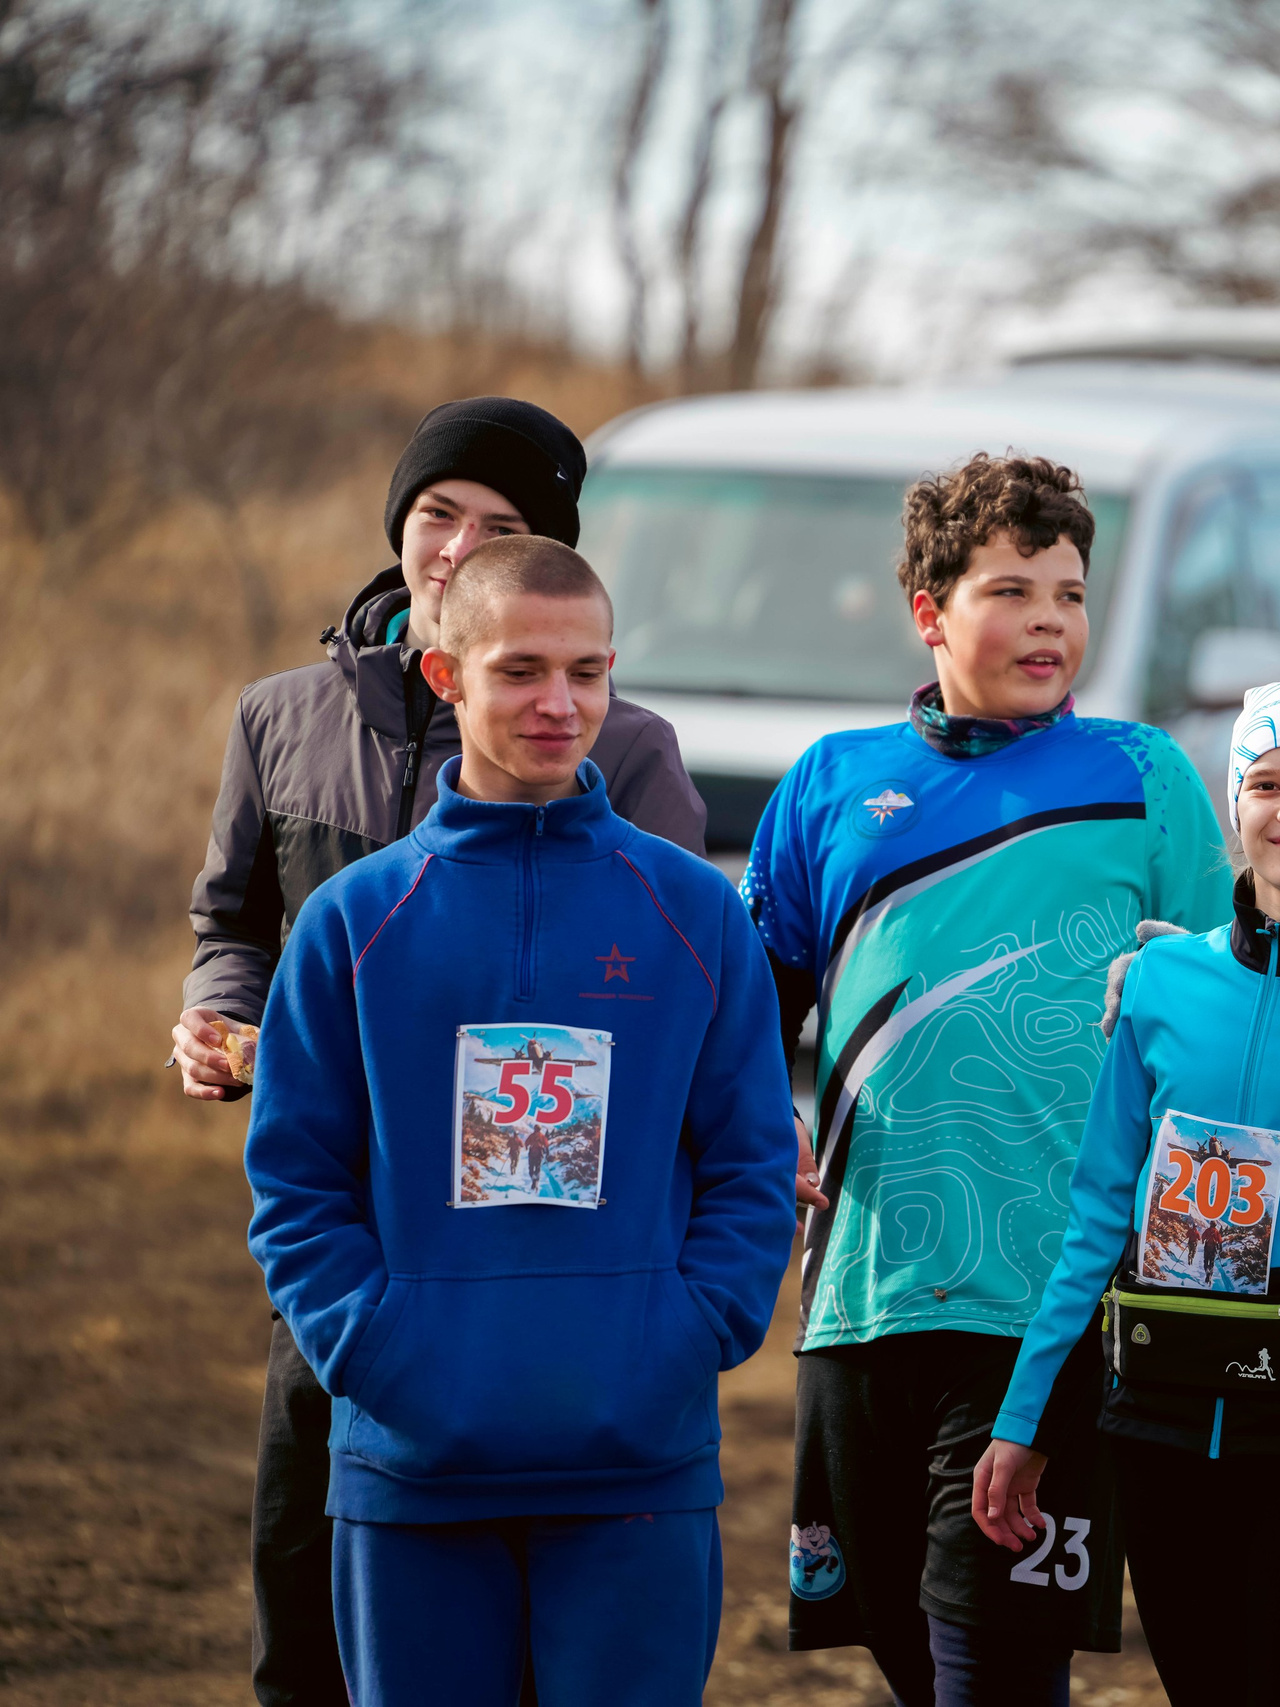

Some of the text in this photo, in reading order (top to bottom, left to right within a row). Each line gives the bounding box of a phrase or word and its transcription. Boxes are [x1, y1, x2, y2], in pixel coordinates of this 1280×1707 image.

[493, 1060, 575, 1126] 55
[1159, 1149, 1267, 1227] 203
[1010, 1511, 1091, 1591] 23
